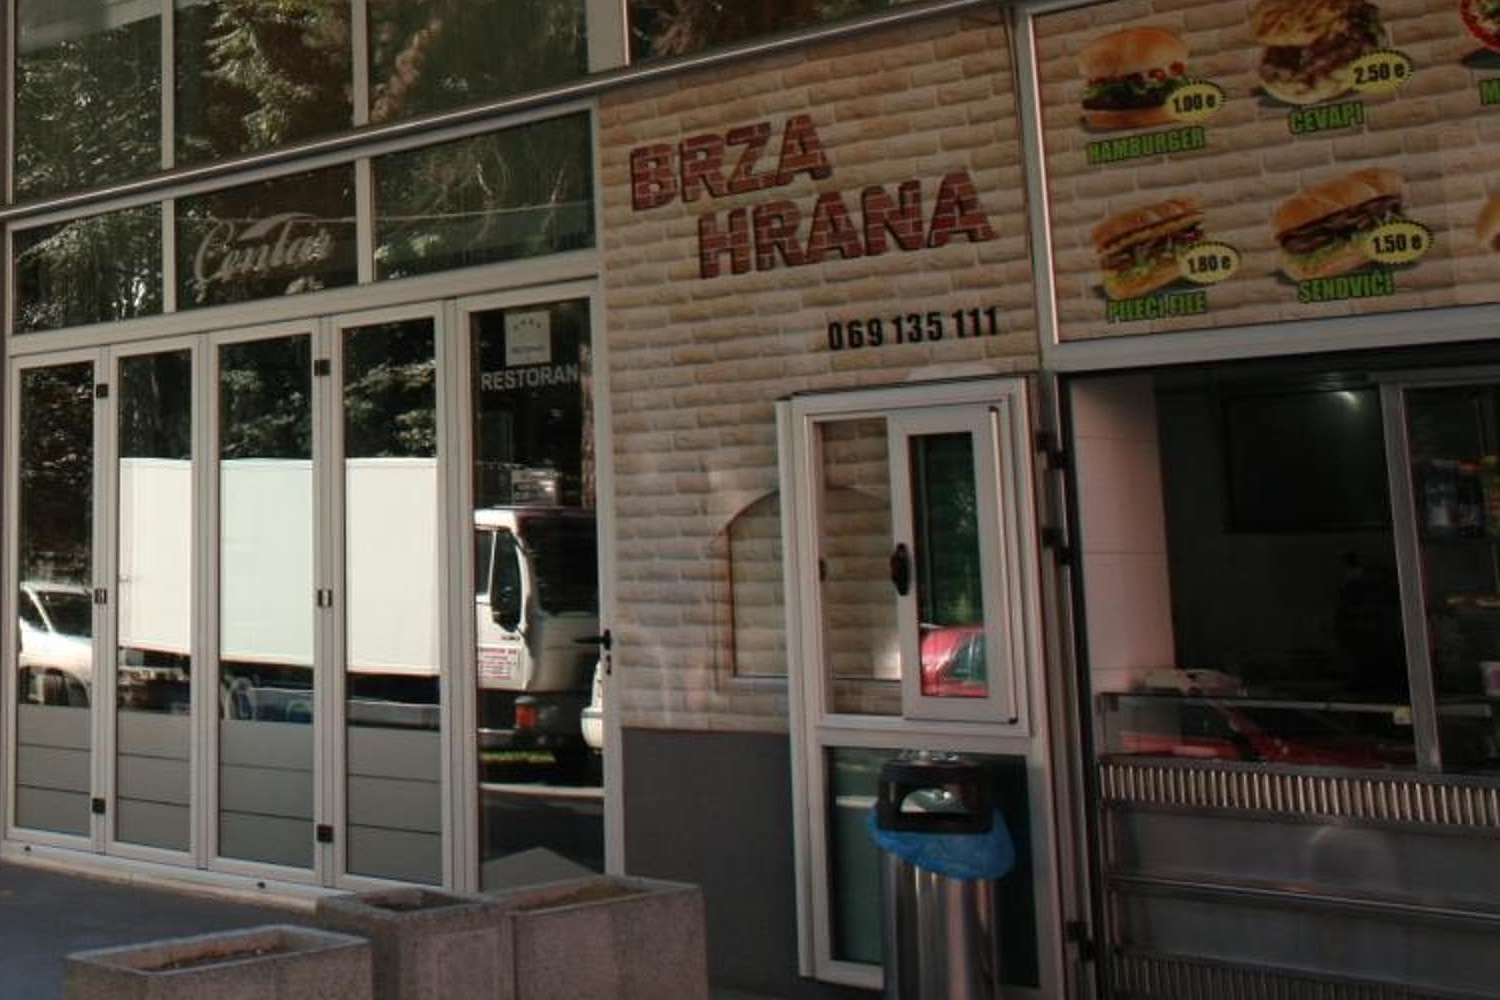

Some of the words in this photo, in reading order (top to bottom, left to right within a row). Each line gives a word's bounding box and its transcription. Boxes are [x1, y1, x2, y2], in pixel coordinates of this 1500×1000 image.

[1354, 63, 1390, 85] 2.50
[630, 113, 833, 212] BRZA
[1088, 126, 1205, 165] HAMBURGER
[699, 170, 999, 280] HRANA
[1372, 233, 1407, 254] 1.50
[827, 316, 884, 352] 069
[892, 311, 944, 346] 135
[951, 305, 999, 339] 111
[481, 362, 580, 392] RESTORAN
